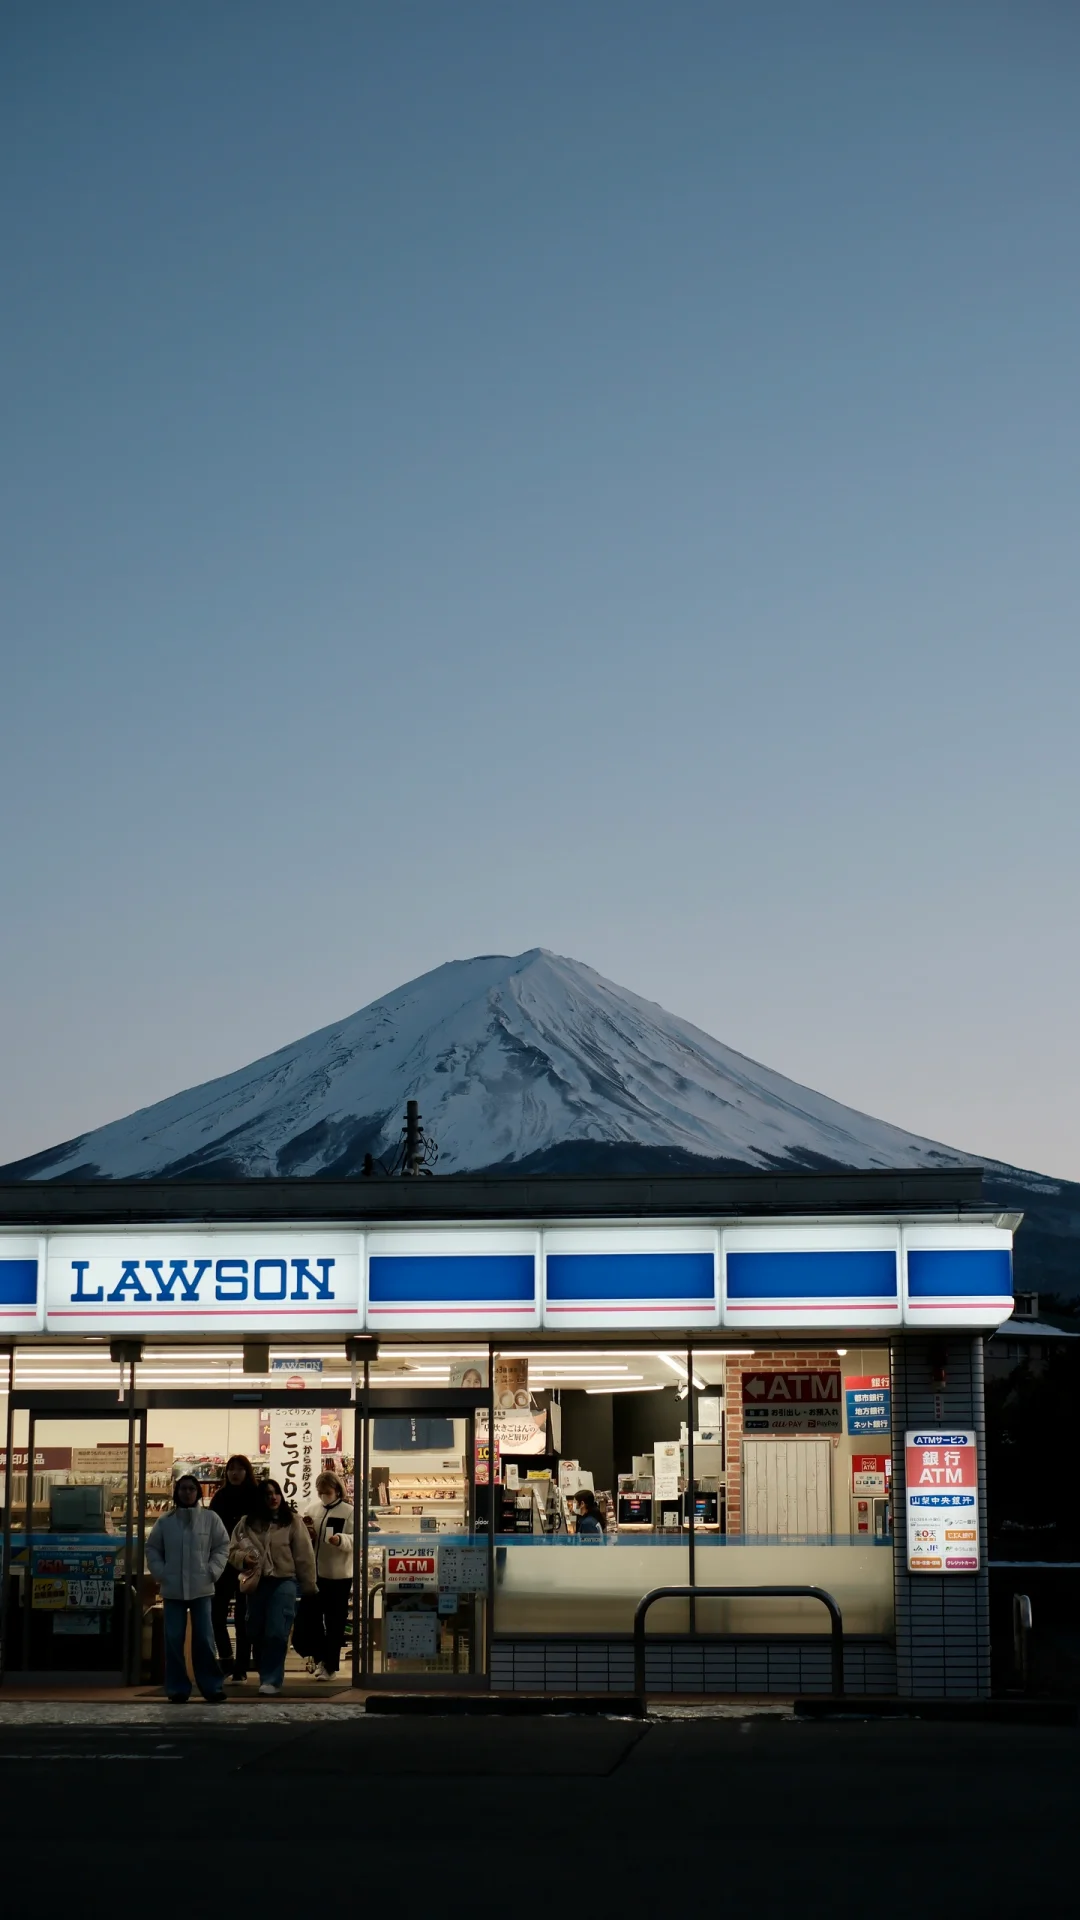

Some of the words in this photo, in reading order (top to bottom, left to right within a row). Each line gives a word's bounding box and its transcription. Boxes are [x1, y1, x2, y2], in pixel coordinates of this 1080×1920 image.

[71, 1259, 335, 1302] LAWSON
[273, 1362, 320, 1370] LAWSON
[767, 1375, 837, 1399] ATM
[871, 1378, 890, 1387] 銀行
[854, 1393, 884, 1402] 都市銀行
[855, 1407, 885, 1415] 地方銀行
[816, 1421, 839, 1429] PayPay
[854, 1420, 888, 1428] ネット銀行
[916, 1436, 965, 1444] ATMサービス
[922, 1451, 960, 1466] 銀行
[302, 1445, 312, 1497] からあげクン
[919, 1468, 963, 1484] ATM
[911, 1496, 972, 1505] 山梨中央銀行
[389, 1548, 434, 1556] ローソン銀行
[395, 1560, 428, 1572] ATM
